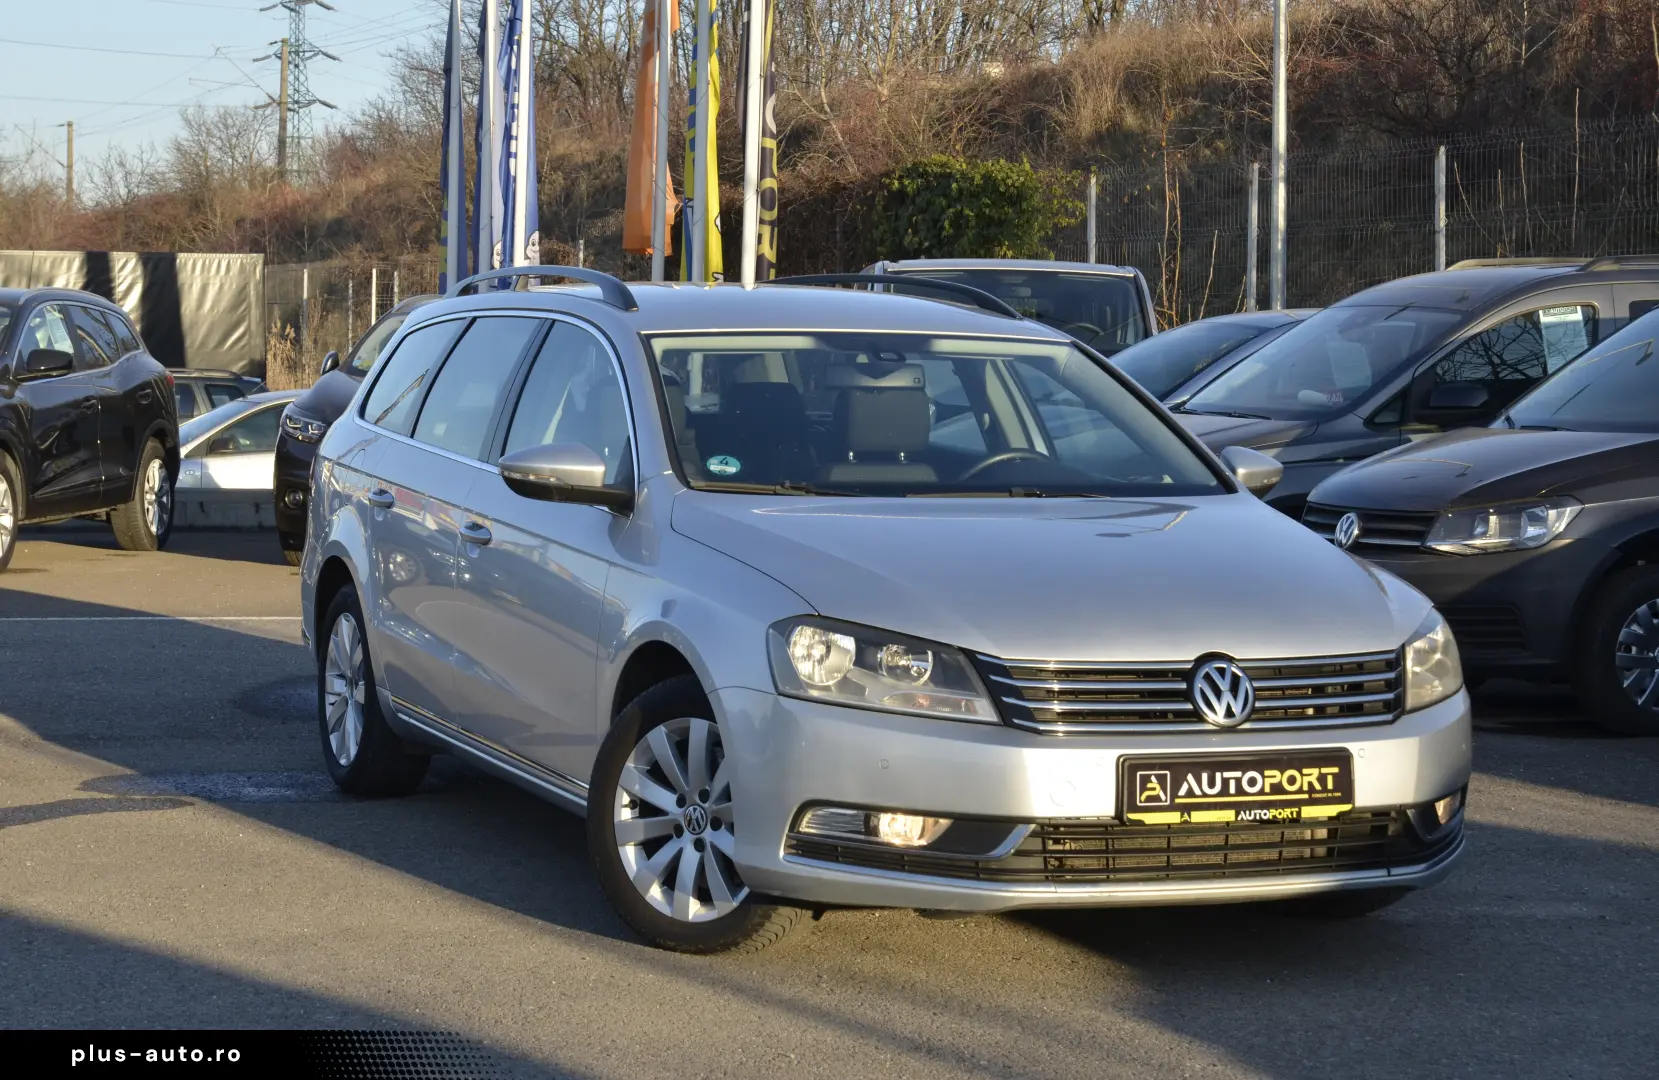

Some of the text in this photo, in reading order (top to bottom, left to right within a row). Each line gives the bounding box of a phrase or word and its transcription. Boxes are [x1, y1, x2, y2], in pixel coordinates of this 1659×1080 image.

[720, 456, 729, 466] 4
[1177, 767, 1340, 796] AUTOPORT
[1237, 807, 1300, 821] AUTOPORT
